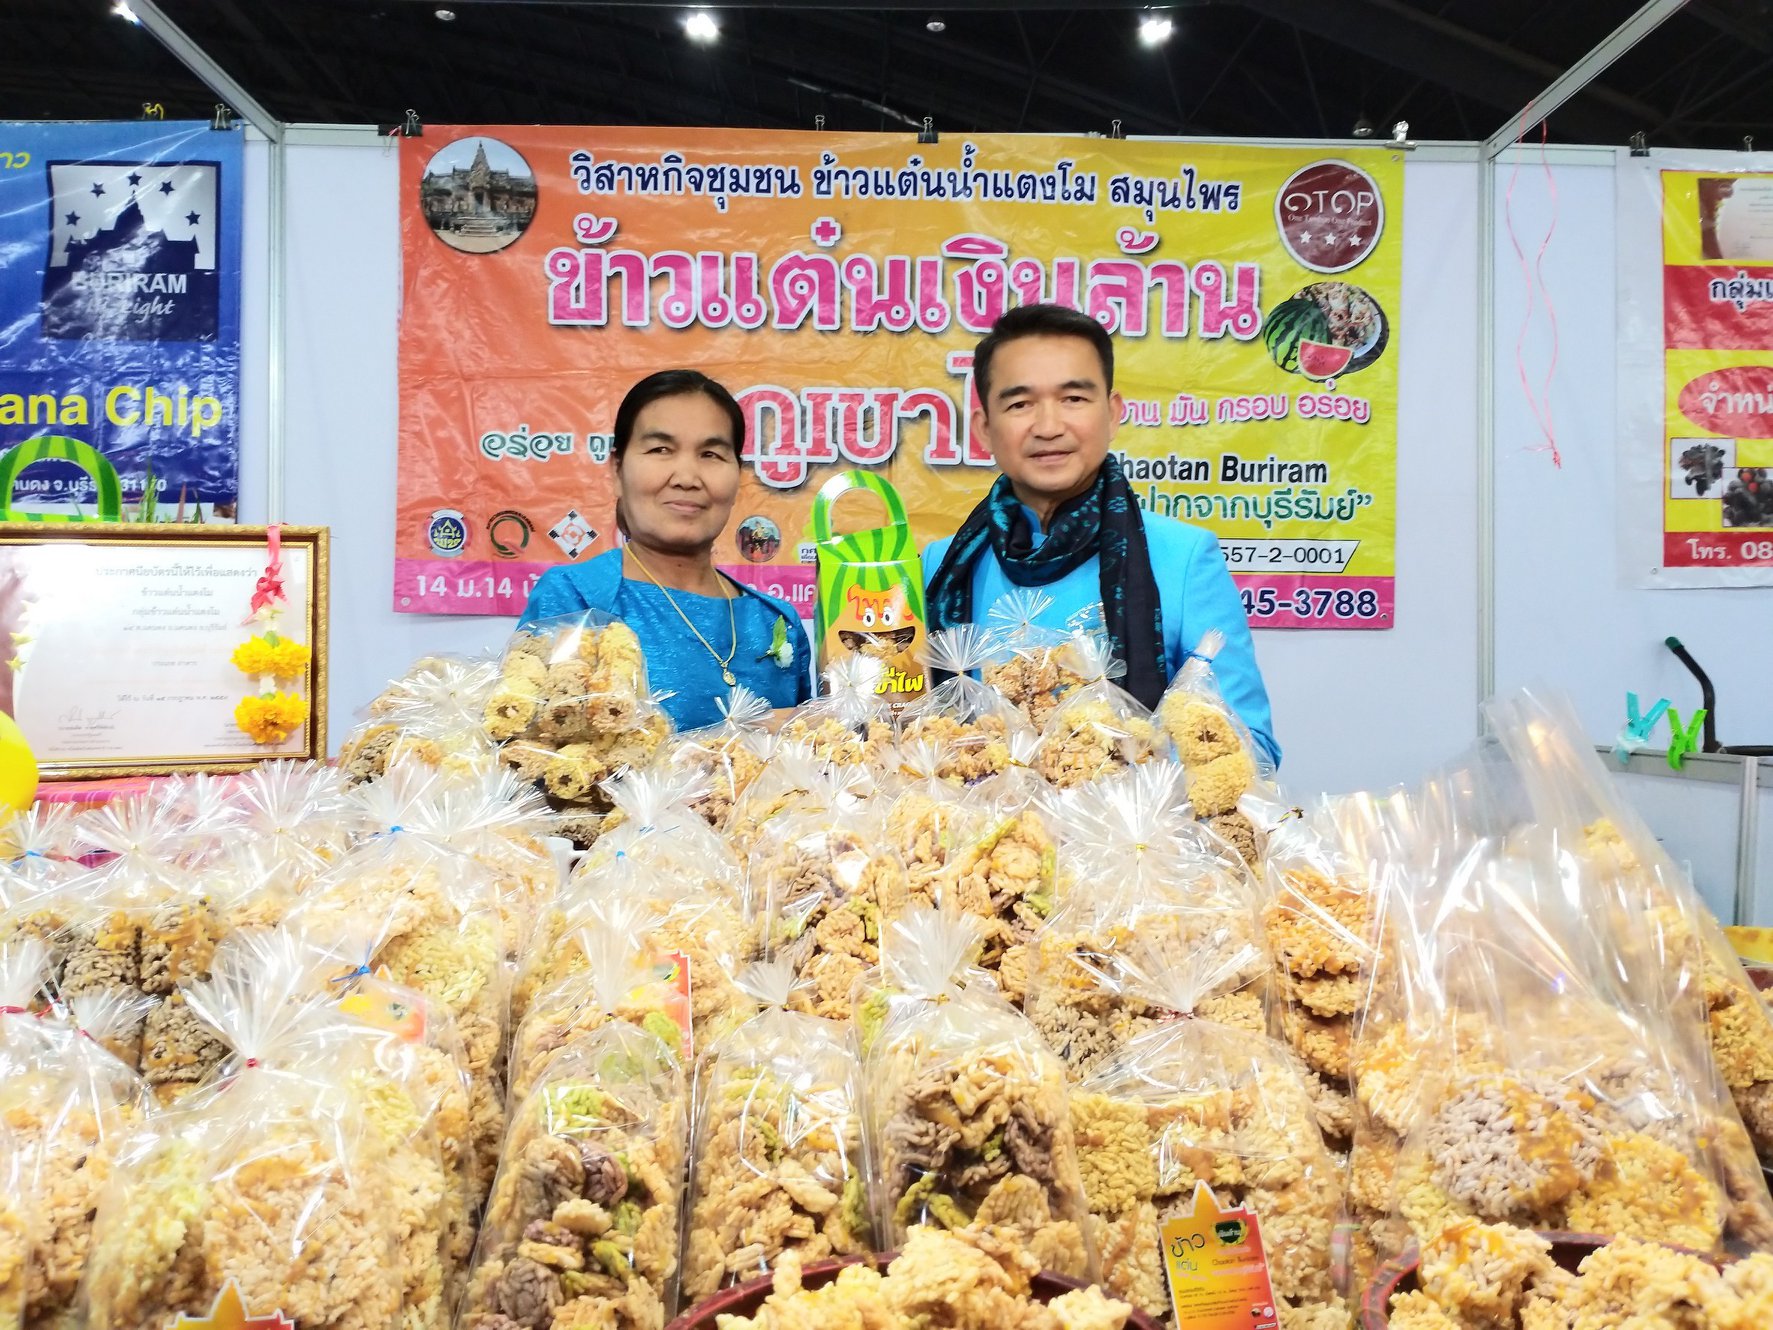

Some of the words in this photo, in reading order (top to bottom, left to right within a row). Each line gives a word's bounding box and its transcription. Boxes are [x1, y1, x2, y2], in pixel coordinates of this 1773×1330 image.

[573, 151, 800, 210] วิสาหกิจชุมชน
[813, 144, 1096, 201] ข้าวแต๋นน้ำแตงโม
[1110, 167, 1241, 222] สมุนไพร
[1284, 190, 1375, 216] OTOP
[546, 213, 1263, 342] ข้าวแต๋นเงินล้าน
[0, 393, 88, 425] ana
[105, 385, 222, 437] Chip
[1170, 395, 1206, 424] มัน
[1217, 394, 1287, 422] กรอบ
[1297, 380, 1369, 424] อร่อย
[482, 425, 572, 460] อร่อย
[1119, 452, 1209, 481] haotan
[1221, 455, 1327, 484] Buriram
[1221, 546, 1346, 565] 557-2-0001
[1687, 538, 1732, 560] โทร.
[416, 575, 447, 598] 14
[457, 576, 513, 599] ม.14
[1171, 1233, 1205, 1257] ข้าว
